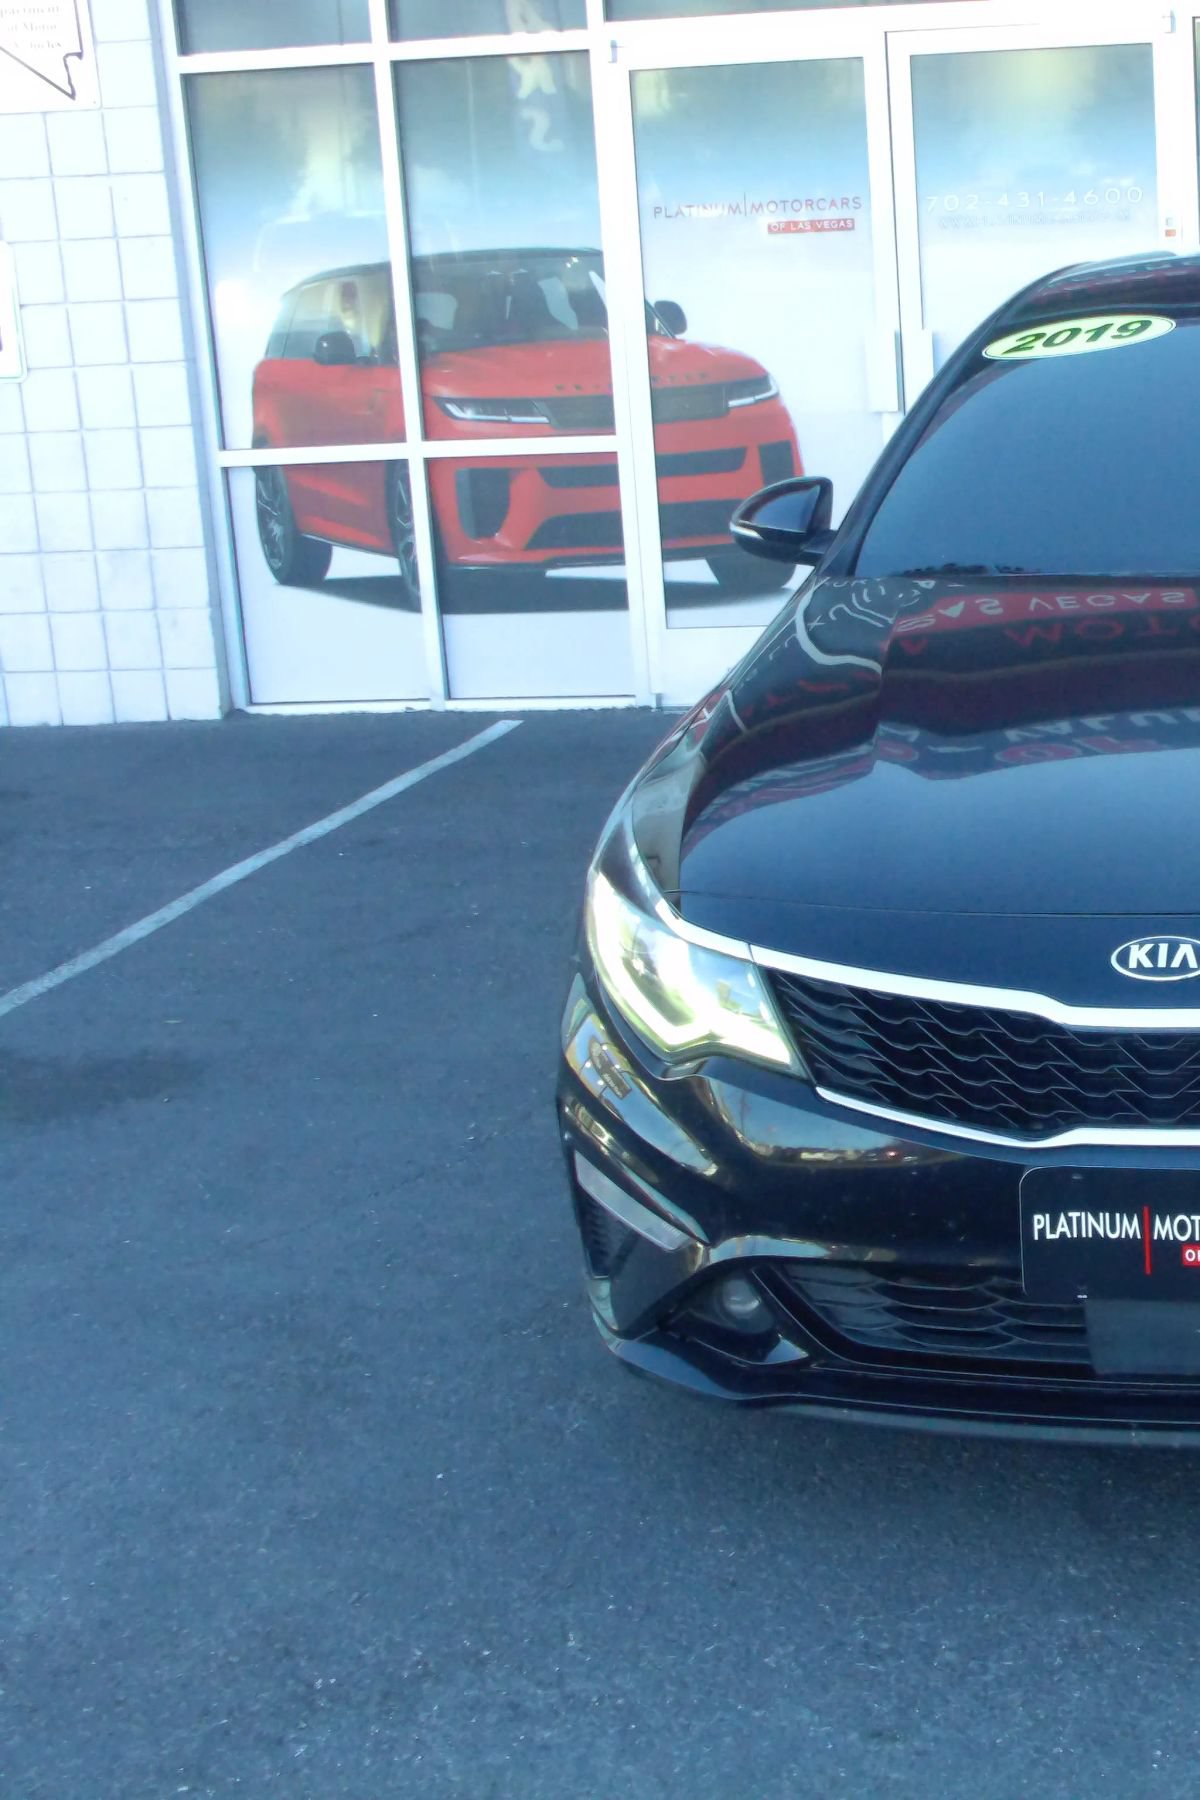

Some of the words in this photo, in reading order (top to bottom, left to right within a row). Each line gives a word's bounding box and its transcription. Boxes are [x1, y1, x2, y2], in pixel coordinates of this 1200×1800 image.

[750, 196, 863, 215] MOTORCARS
[925, 186, 1144, 214] 702-431-4600
[770, 222, 786, 232] OF
[790, 220, 811, 231] LAS
[816, 218, 853, 230] VEGAS
[1001, 319, 1153, 356] 2019
[1128, 942, 1199, 969] KIA
[1033, 1211, 1141, 1240] PLATINUM
